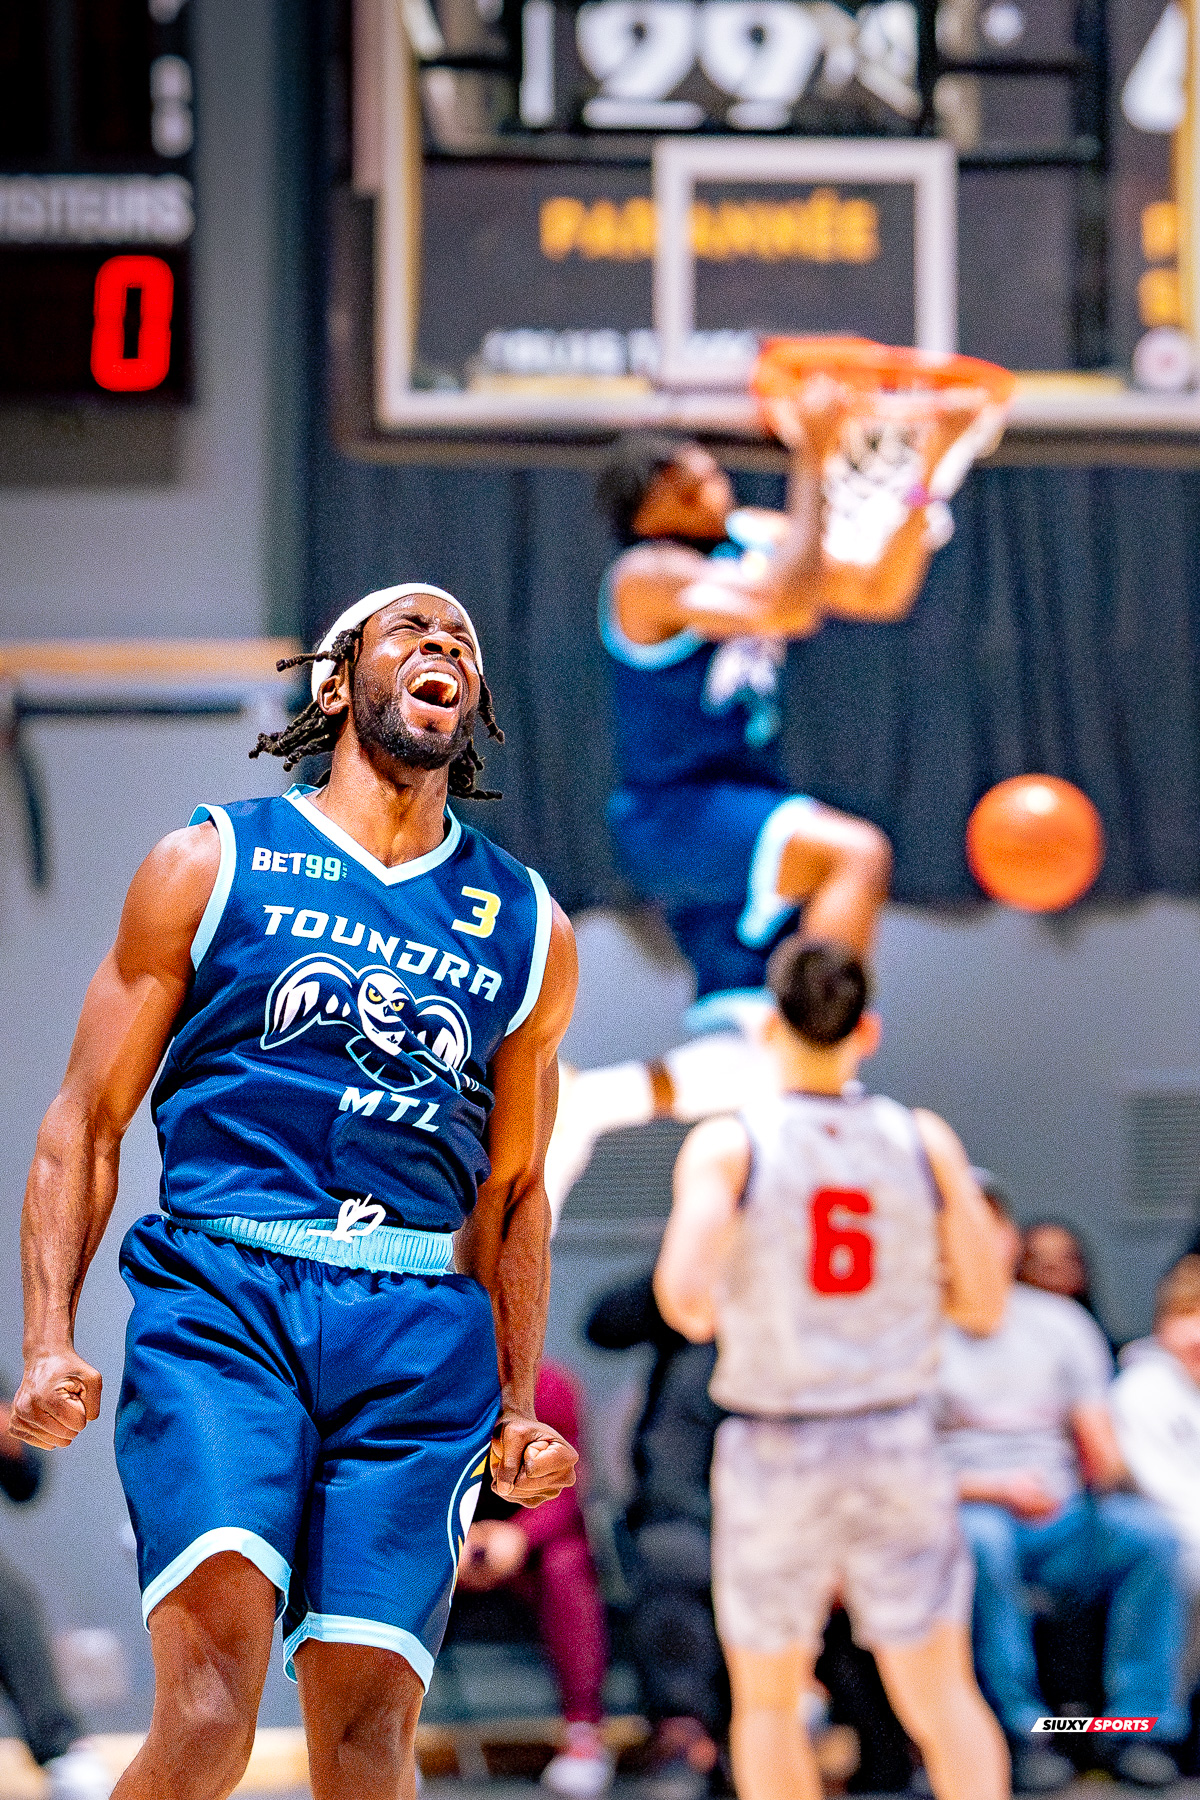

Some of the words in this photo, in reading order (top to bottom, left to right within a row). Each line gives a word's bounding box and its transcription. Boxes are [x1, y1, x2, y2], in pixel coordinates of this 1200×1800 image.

[91, 255, 174, 391] 0
[251, 847, 342, 881] BET99
[452, 886, 501, 938] 3
[263, 905, 502, 1002] TOUNDRA
[338, 1086, 441, 1133] MTL
[810, 1188, 875, 1296] 6
